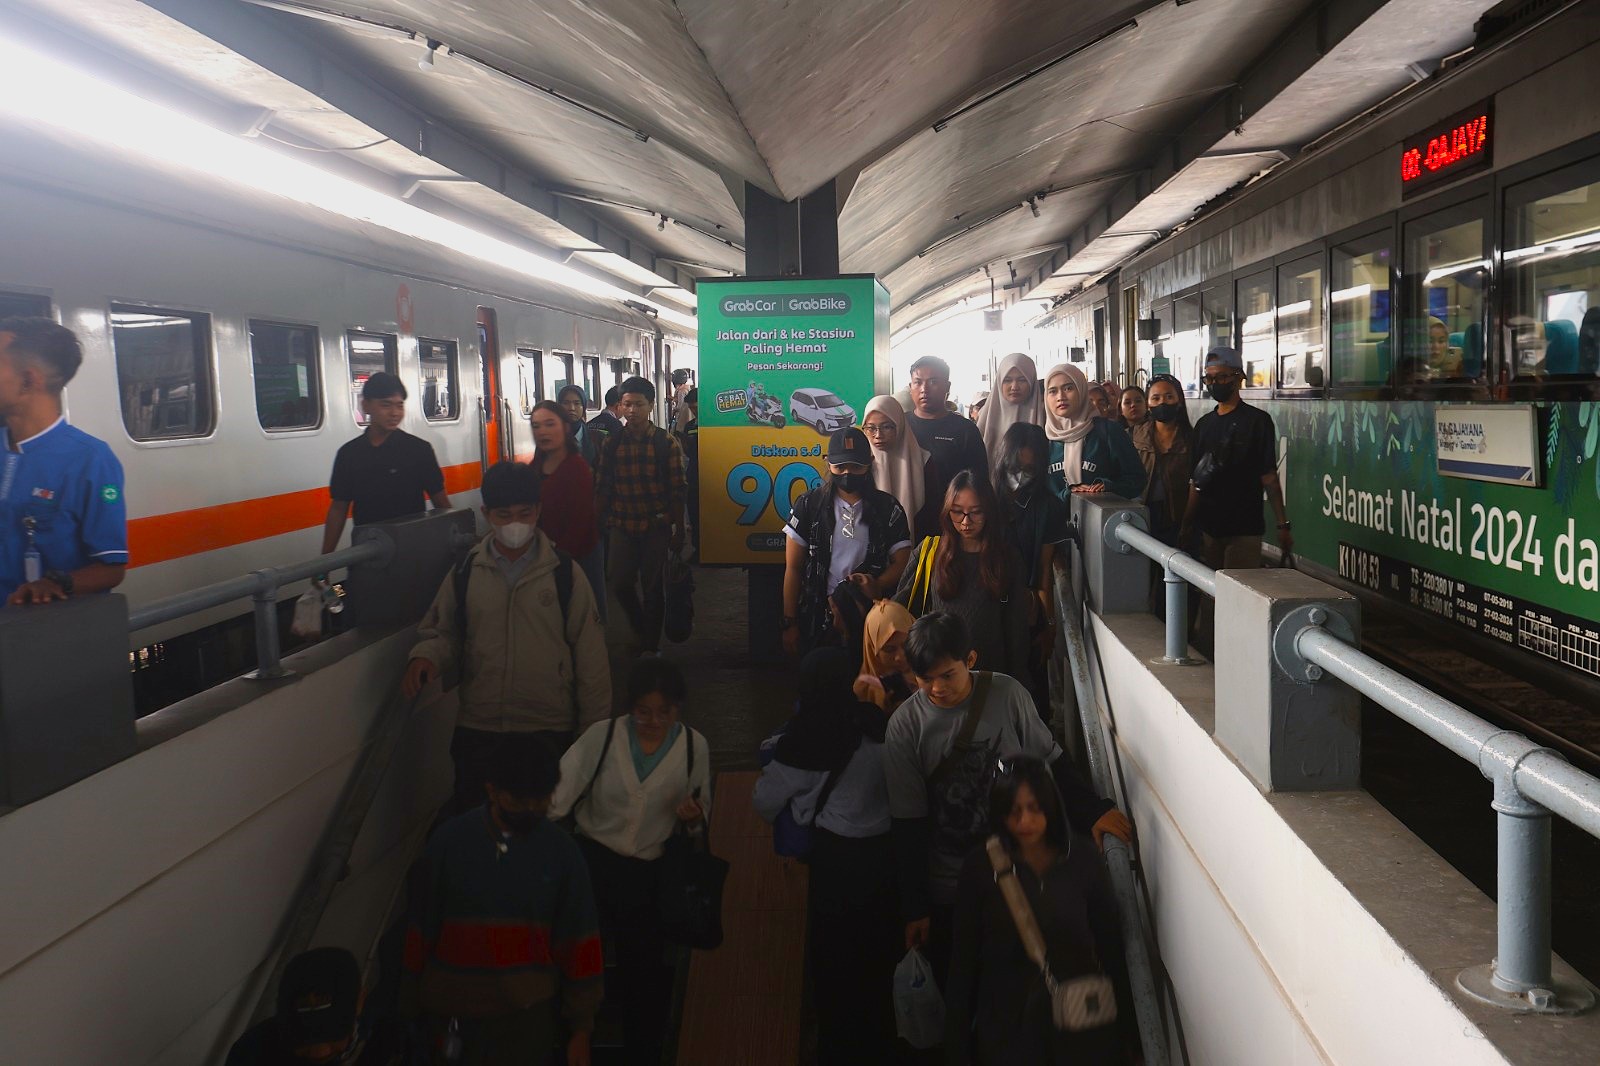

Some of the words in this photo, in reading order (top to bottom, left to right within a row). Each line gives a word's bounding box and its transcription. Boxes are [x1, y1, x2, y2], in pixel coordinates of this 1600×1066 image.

[724, 300, 777, 312] GrabCar
[789, 297, 846, 311] GrabBike
[716, 329, 749, 341] Jalan
[752, 328, 777, 340] dari
[779, 329, 788, 340] &
[791, 328, 806, 339] ke
[808, 327, 855, 339] Stasiun
[743, 343, 783, 356] Paling
[785, 342, 827, 354] Hemat
[747, 361, 775, 371] Pesan
[776, 360, 823, 372] Sekarang!
[751, 444, 798, 457] Diskon
[726, 461, 825, 526] 90
[1322, 473, 1394, 536] Selamat
[1401, 489, 1463, 556] Natal
[1470, 502, 1544, 577] 2024
[1554, 517, 1600, 593] da
[1411, 567, 1420, 585] TS
[1448, 580, 1454, 597] V
[1483, 608, 1513, 627] 27-02-2024
